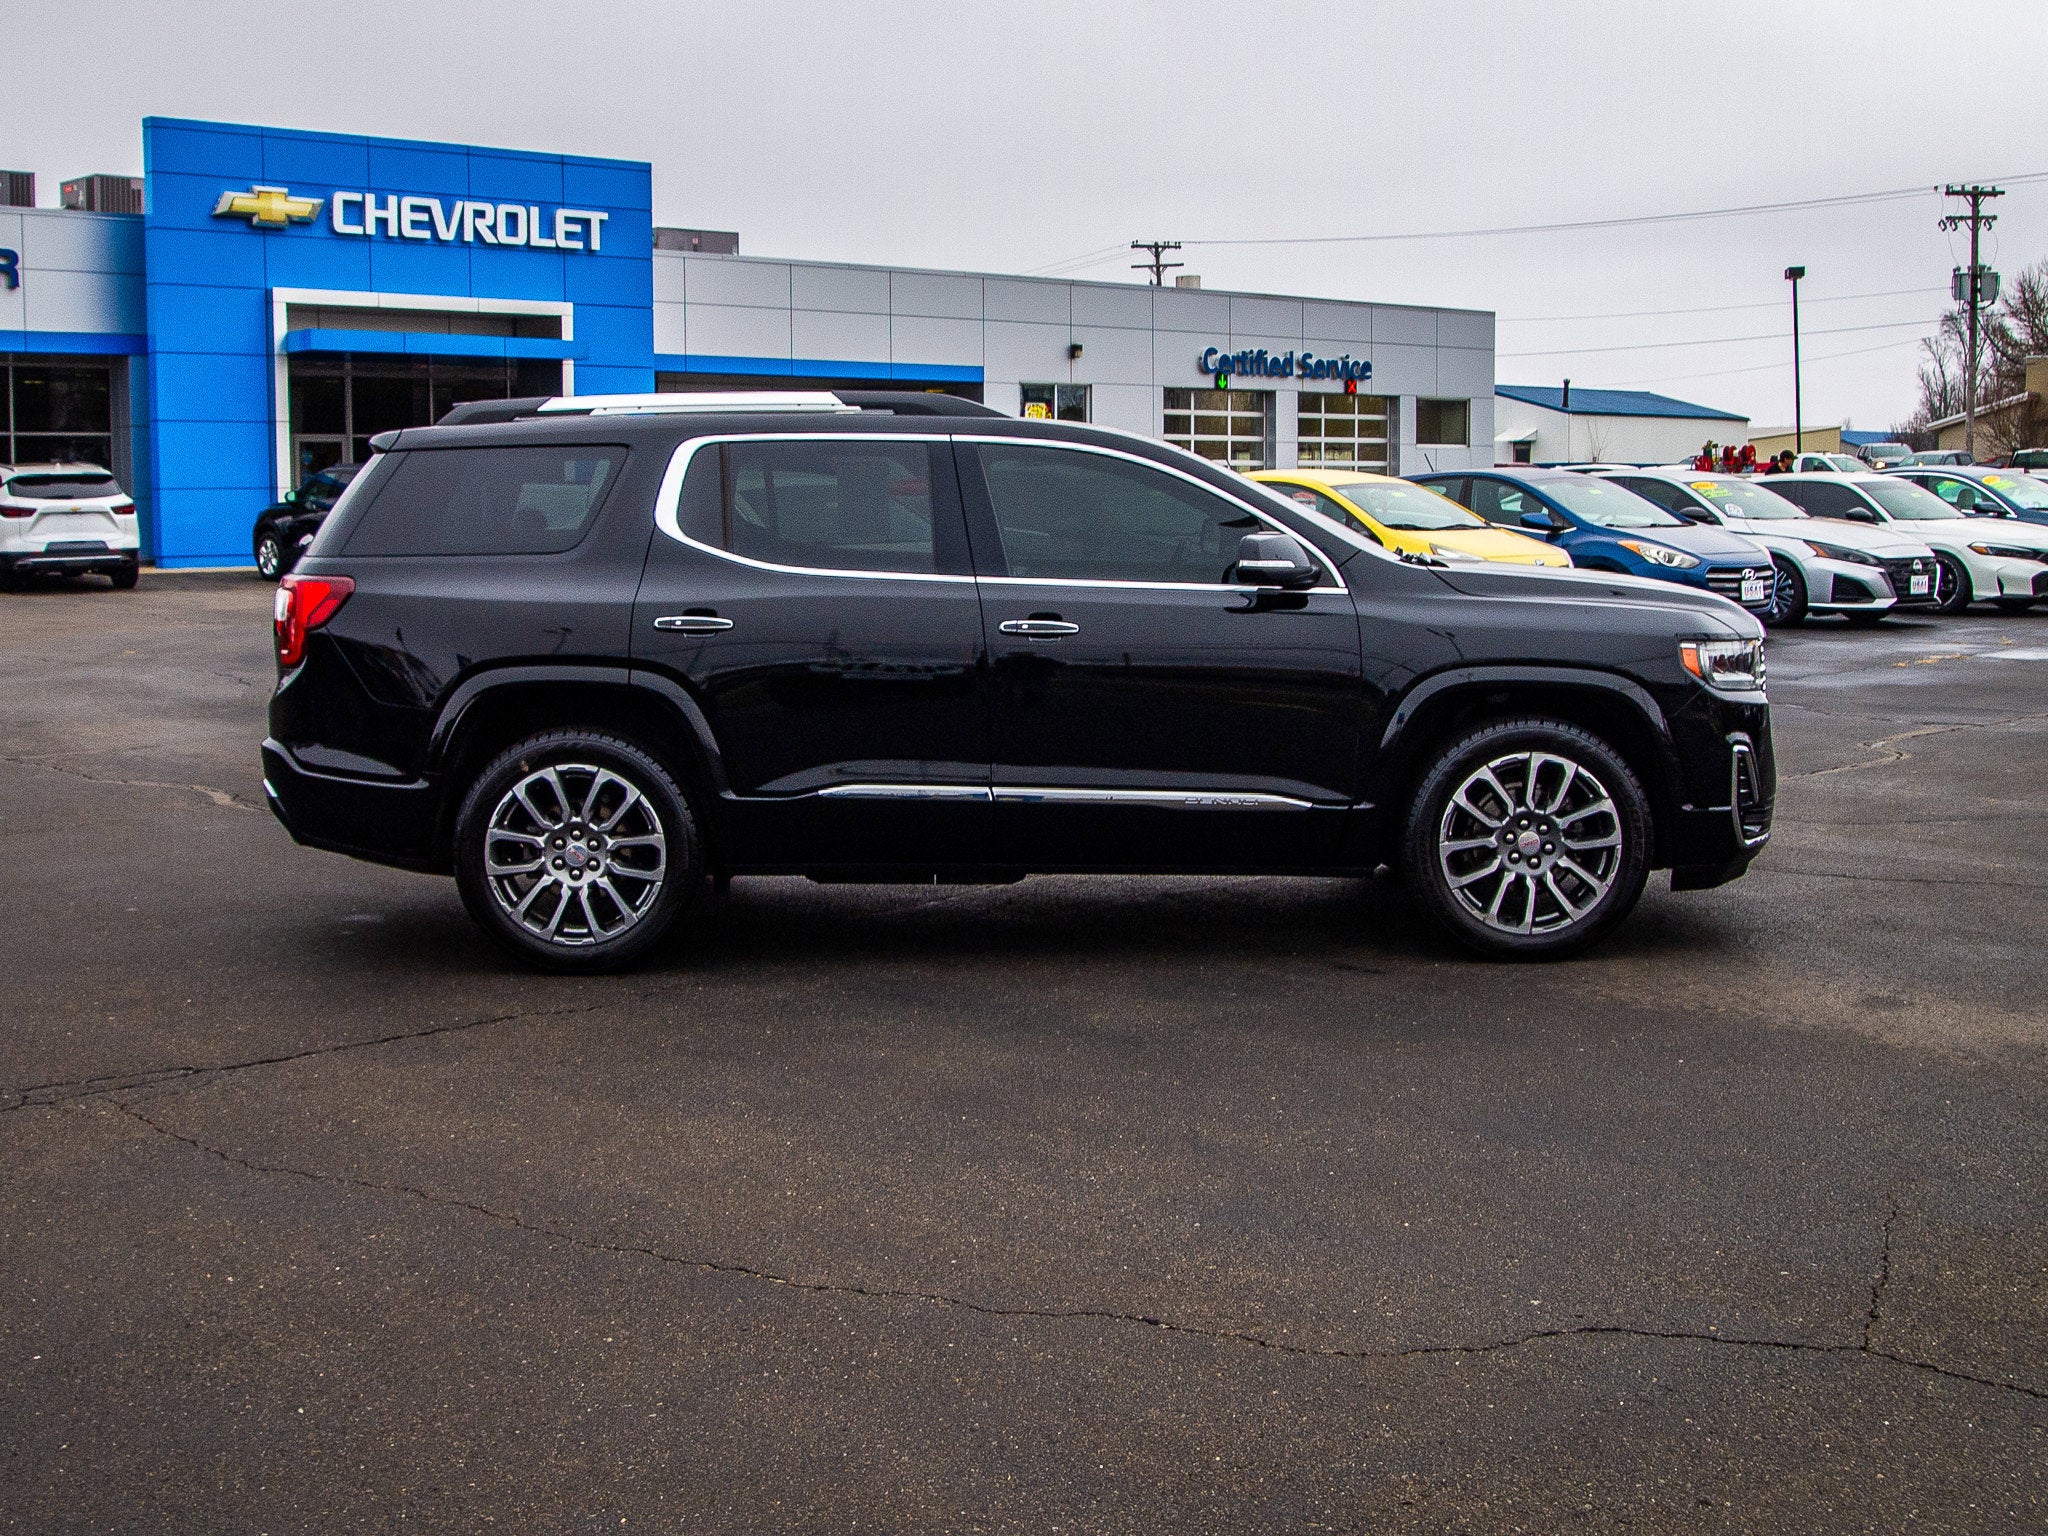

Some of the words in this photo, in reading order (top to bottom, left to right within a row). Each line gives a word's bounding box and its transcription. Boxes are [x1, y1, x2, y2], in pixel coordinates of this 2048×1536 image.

[332, 191, 608, 251] CHEVROLET
[1202, 347, 1295, 377] Certified
[1300, 352, 1373, 380] Service
